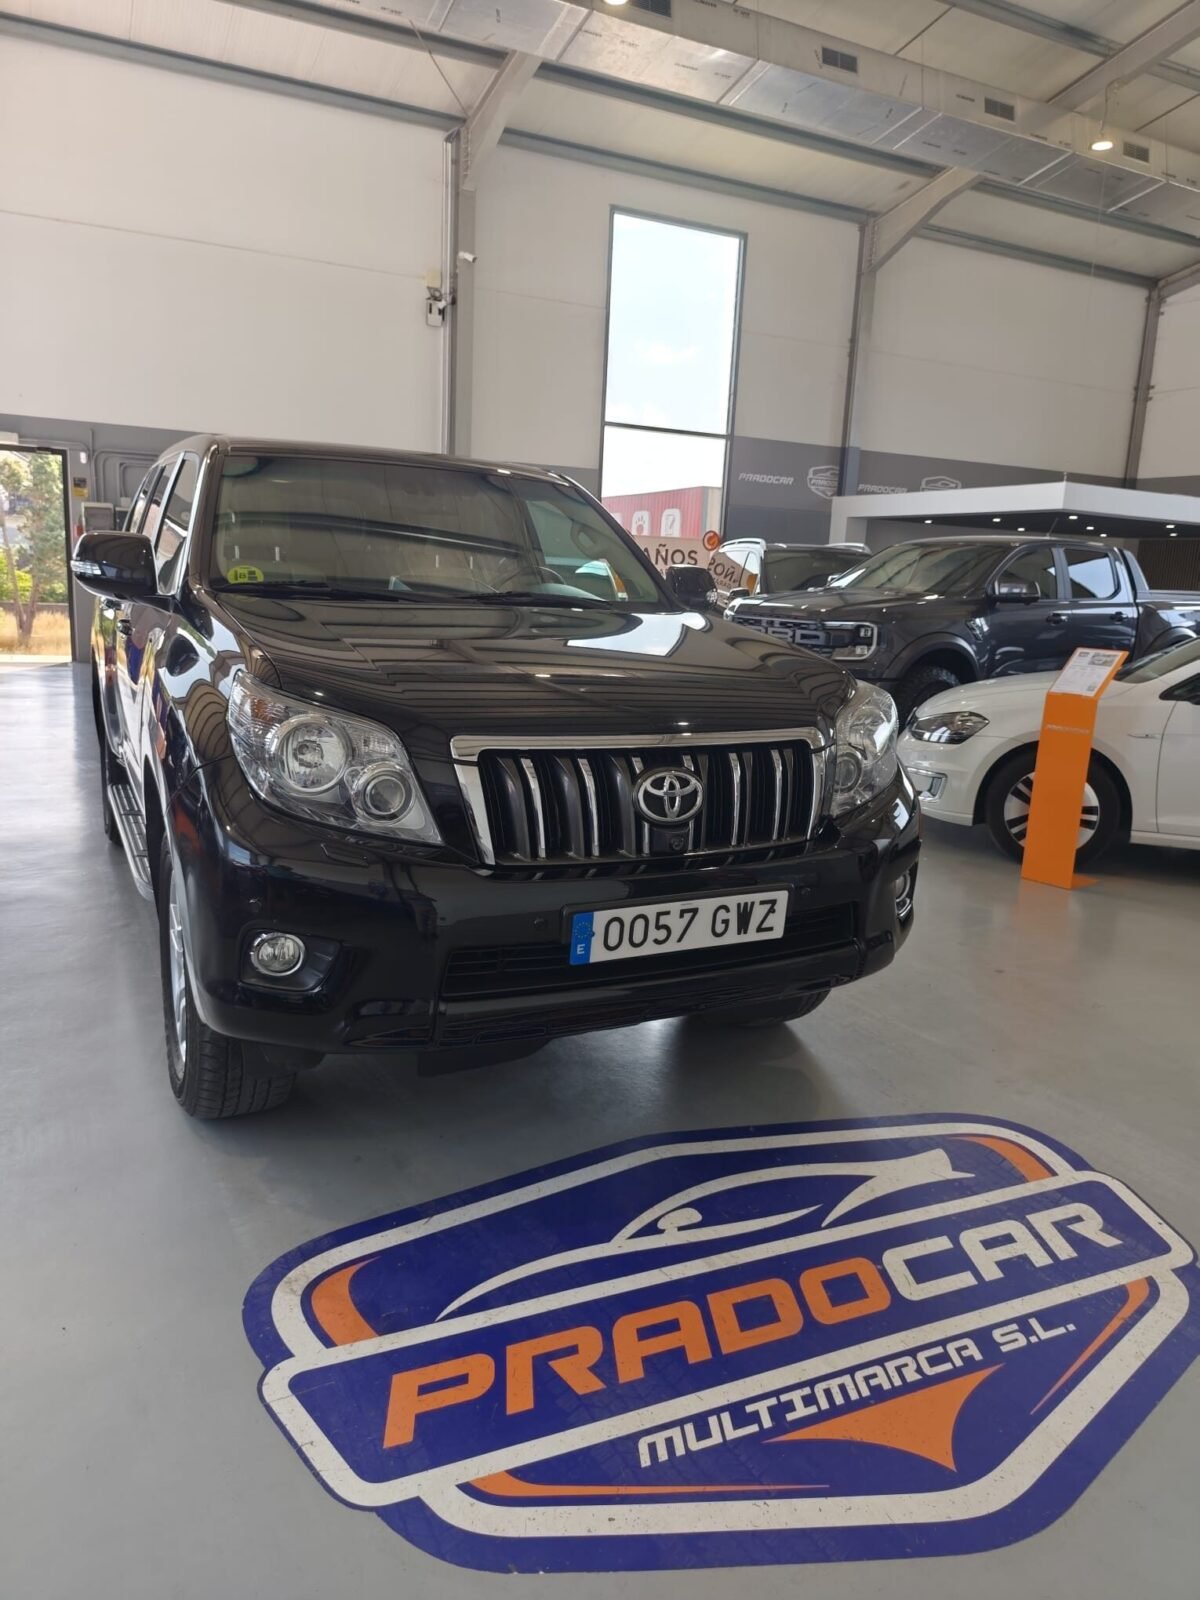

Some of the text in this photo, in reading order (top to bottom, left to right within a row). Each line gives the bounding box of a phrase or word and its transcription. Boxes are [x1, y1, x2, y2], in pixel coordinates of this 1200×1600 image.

[738, 472, 794, 485] PRADOCAR
[576, 943, 585, 954] E
[602, 898, 778, 951] 0057 GWZ
[383, 1202, 1123, 1448] PRADOCAR
[638, 1317, 1077, 1468] MULTIMARCA S.L.
